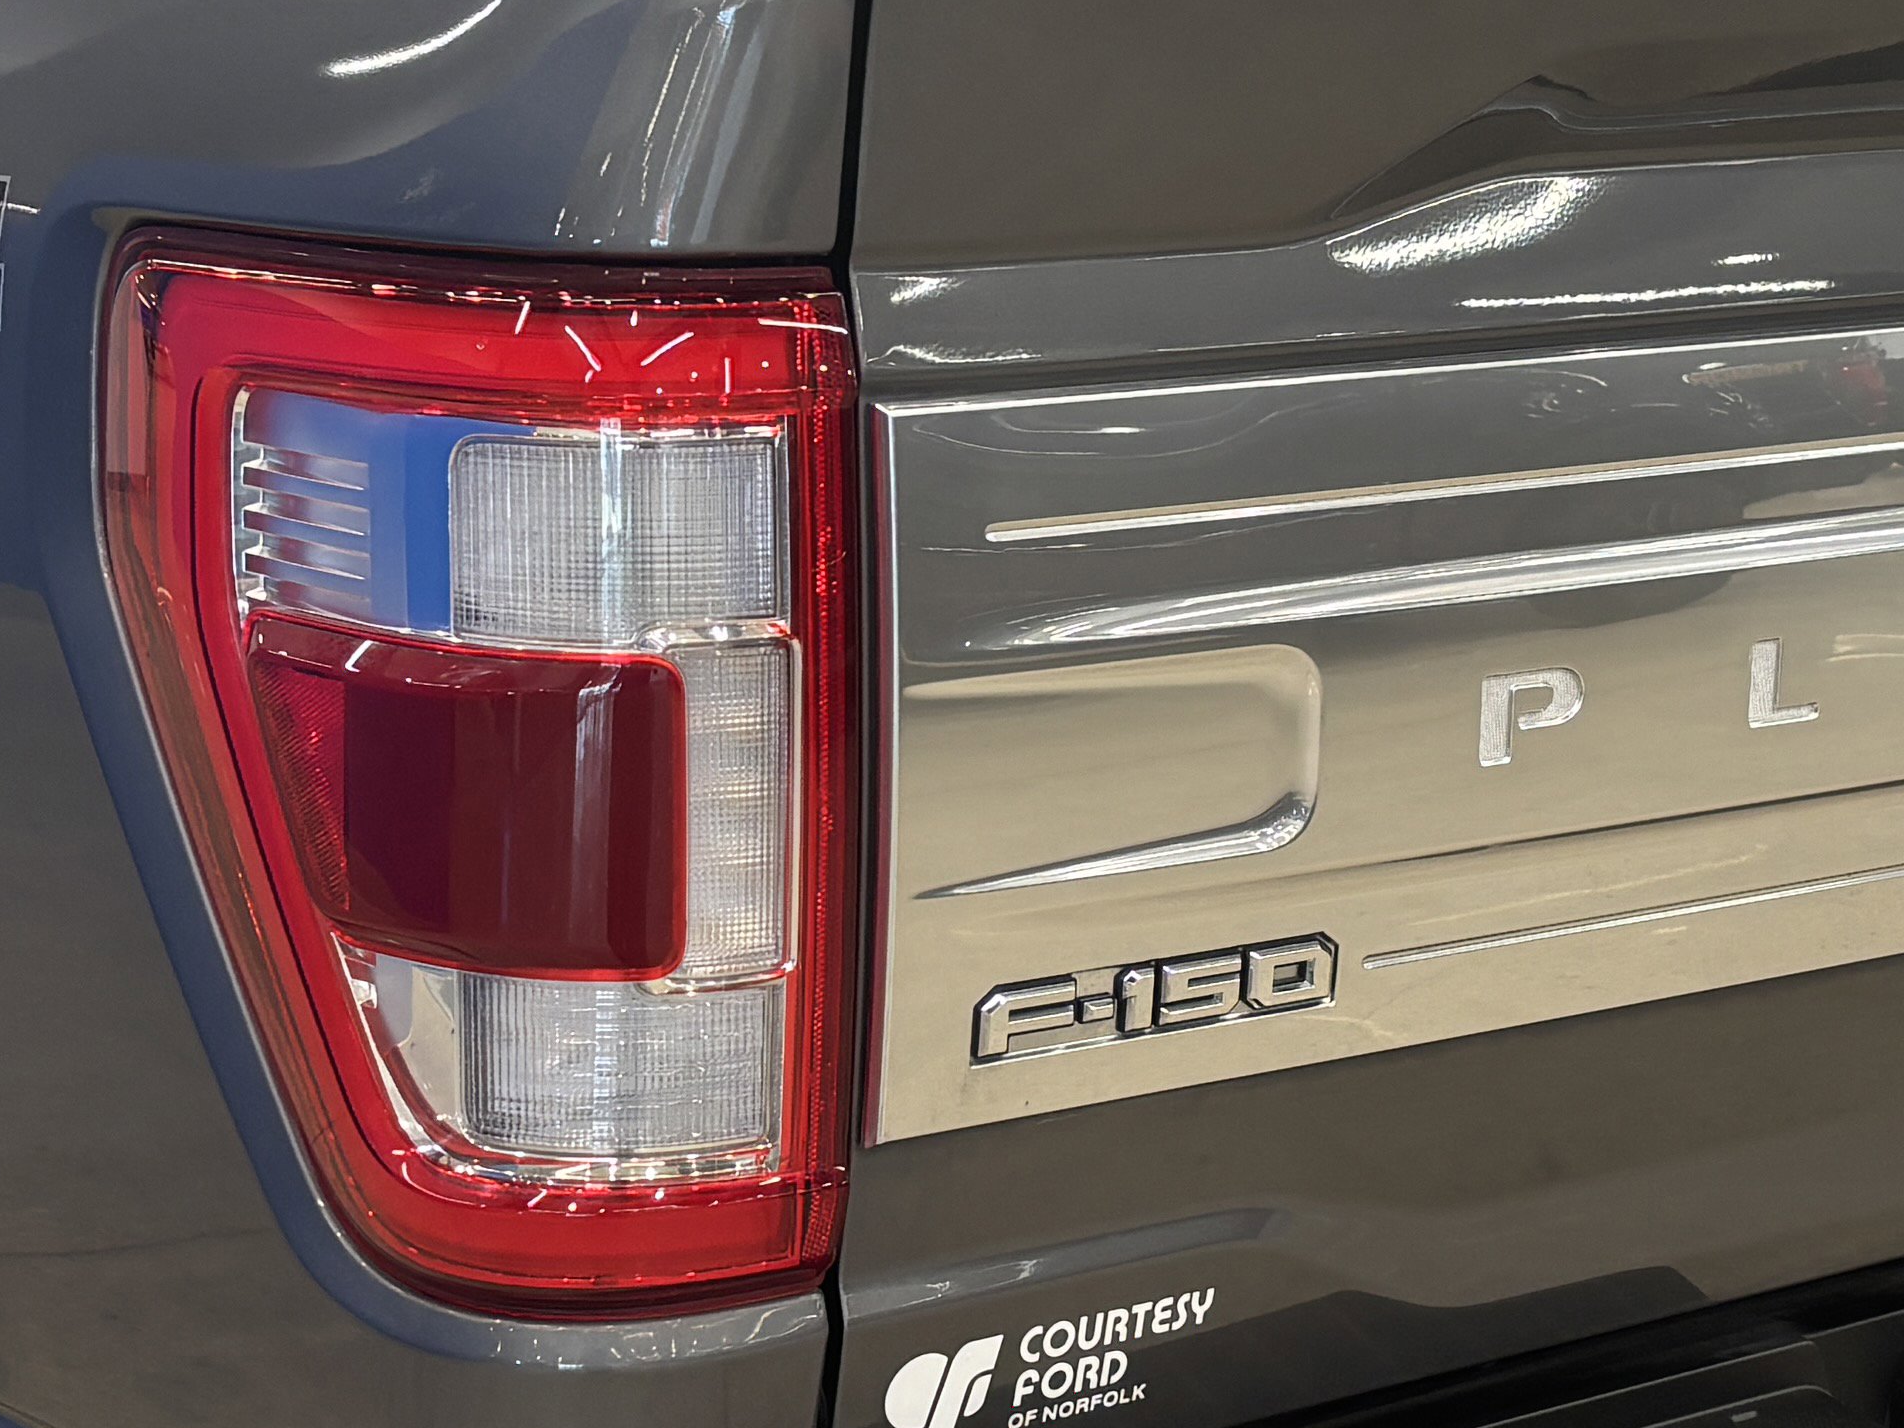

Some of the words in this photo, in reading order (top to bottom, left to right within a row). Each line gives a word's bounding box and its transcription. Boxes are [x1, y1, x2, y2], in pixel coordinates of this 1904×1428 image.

[971, 930, 1339, 1069] F-150
[1019, 1287, 1215, 1363] COURTESY
[1011, 1350, 1128, 1408] FORD
[1041, 1383, 1147, 1423] NORFOLK
